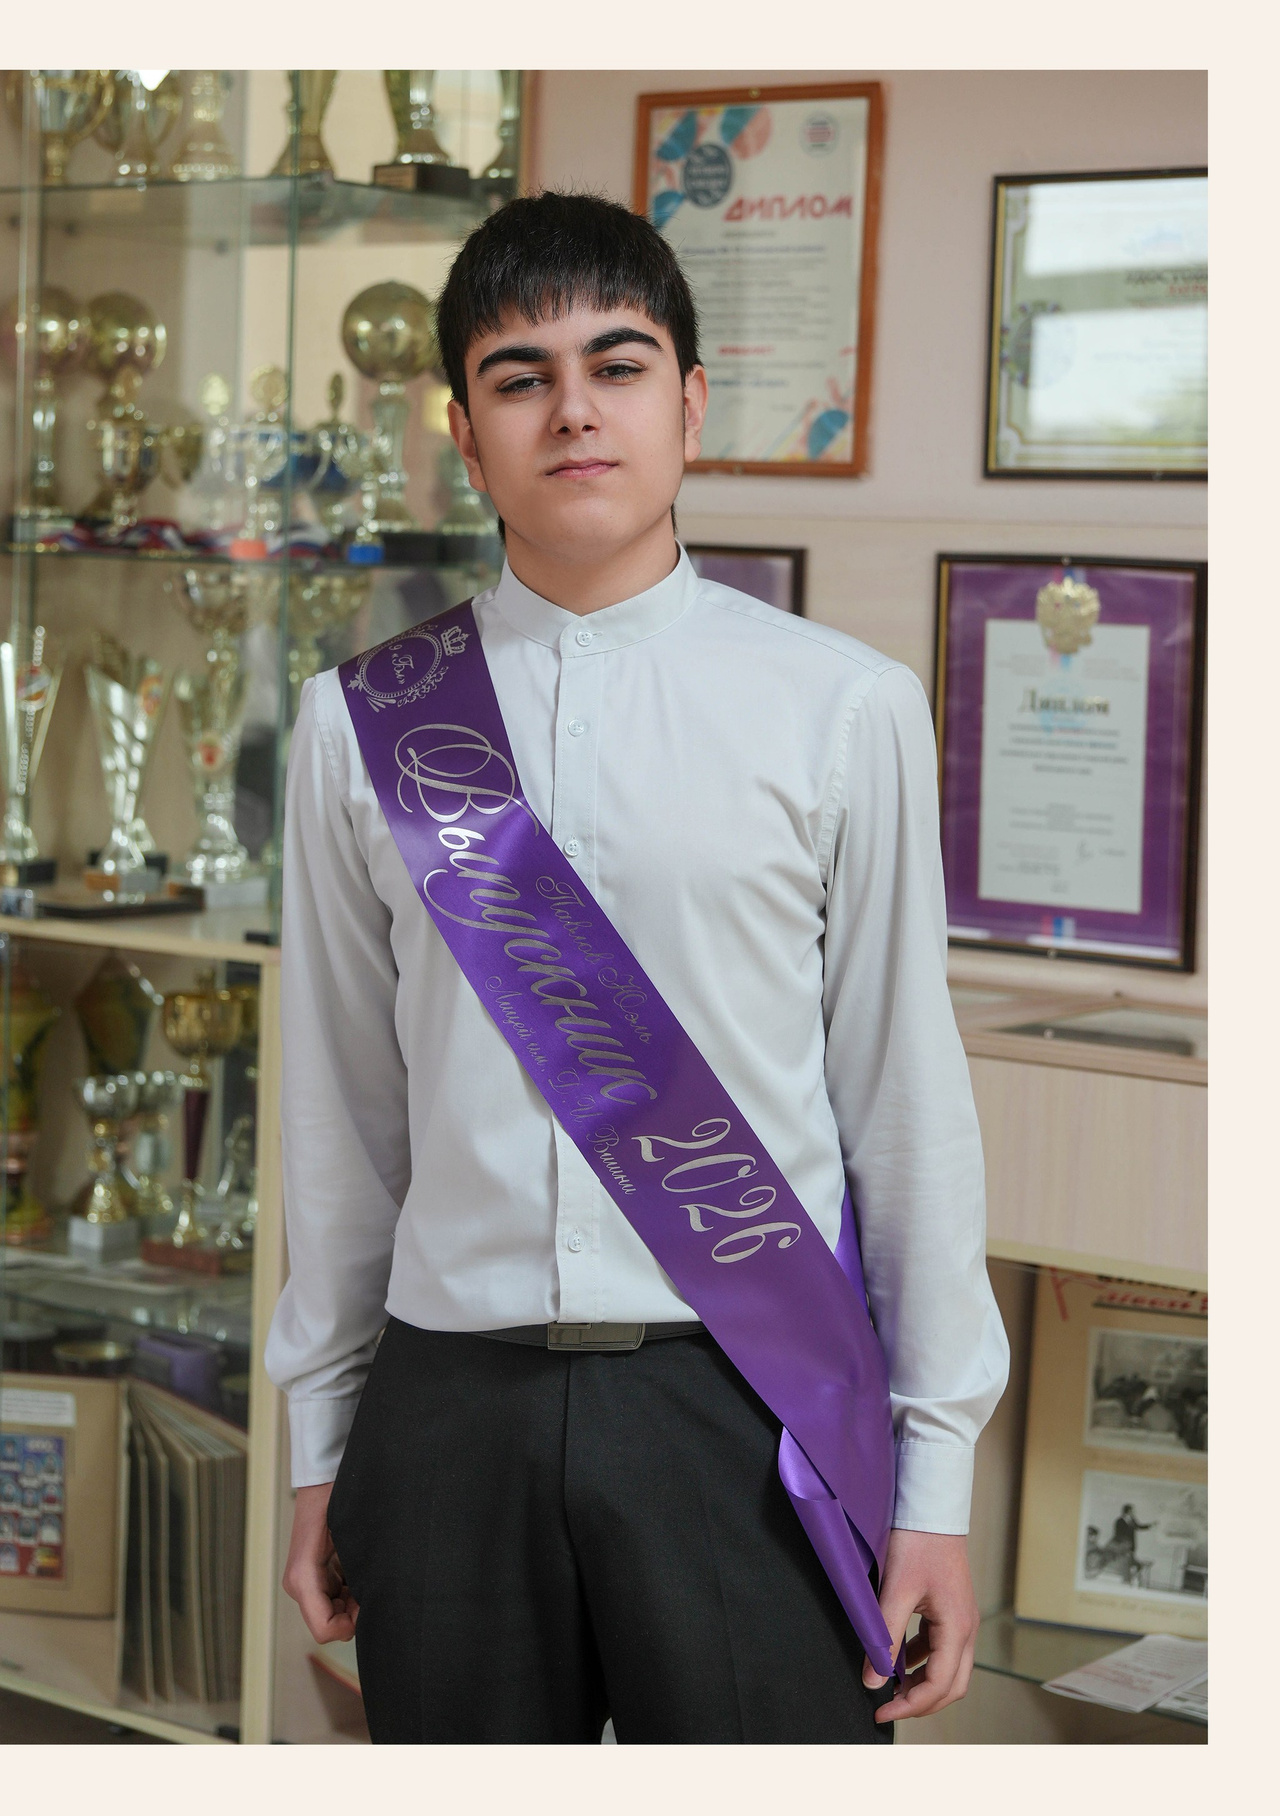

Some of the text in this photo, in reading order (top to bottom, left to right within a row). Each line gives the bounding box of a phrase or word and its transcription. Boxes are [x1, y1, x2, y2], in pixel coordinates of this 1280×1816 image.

[395, 723, 658, 1106] Выпускник
[535, 875, 615, 964] Павлов
[484, 975, 535, 1041] Лицей
[586, 1123, 637, 1196] Вишни
[631, 1117, 802, 1264] 2026
